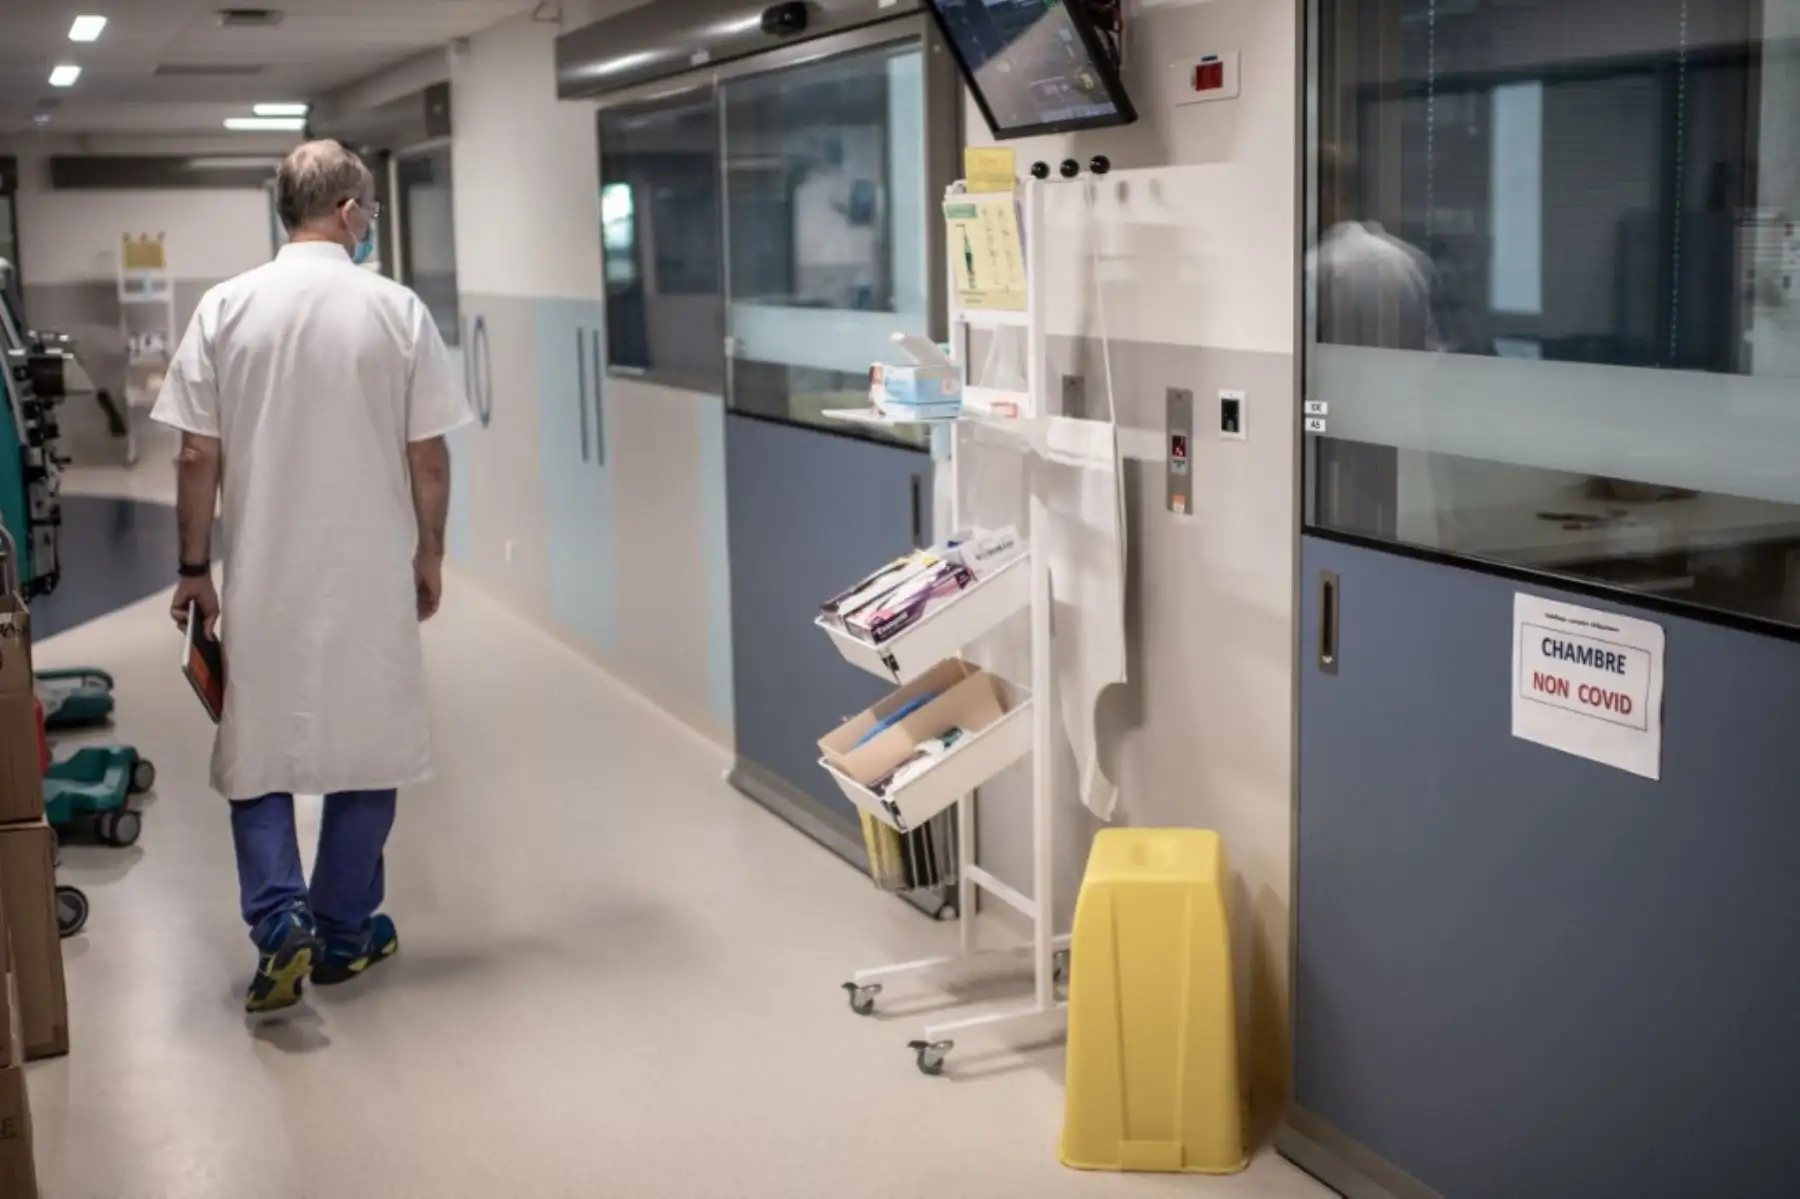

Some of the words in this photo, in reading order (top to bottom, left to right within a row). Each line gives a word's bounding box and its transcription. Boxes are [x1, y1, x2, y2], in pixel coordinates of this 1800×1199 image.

[1542, 637, 1626, 675] CHAMBRE
[1533, 671, 1569, 699] NON
[1578, 683, 1632, 715] COVID
